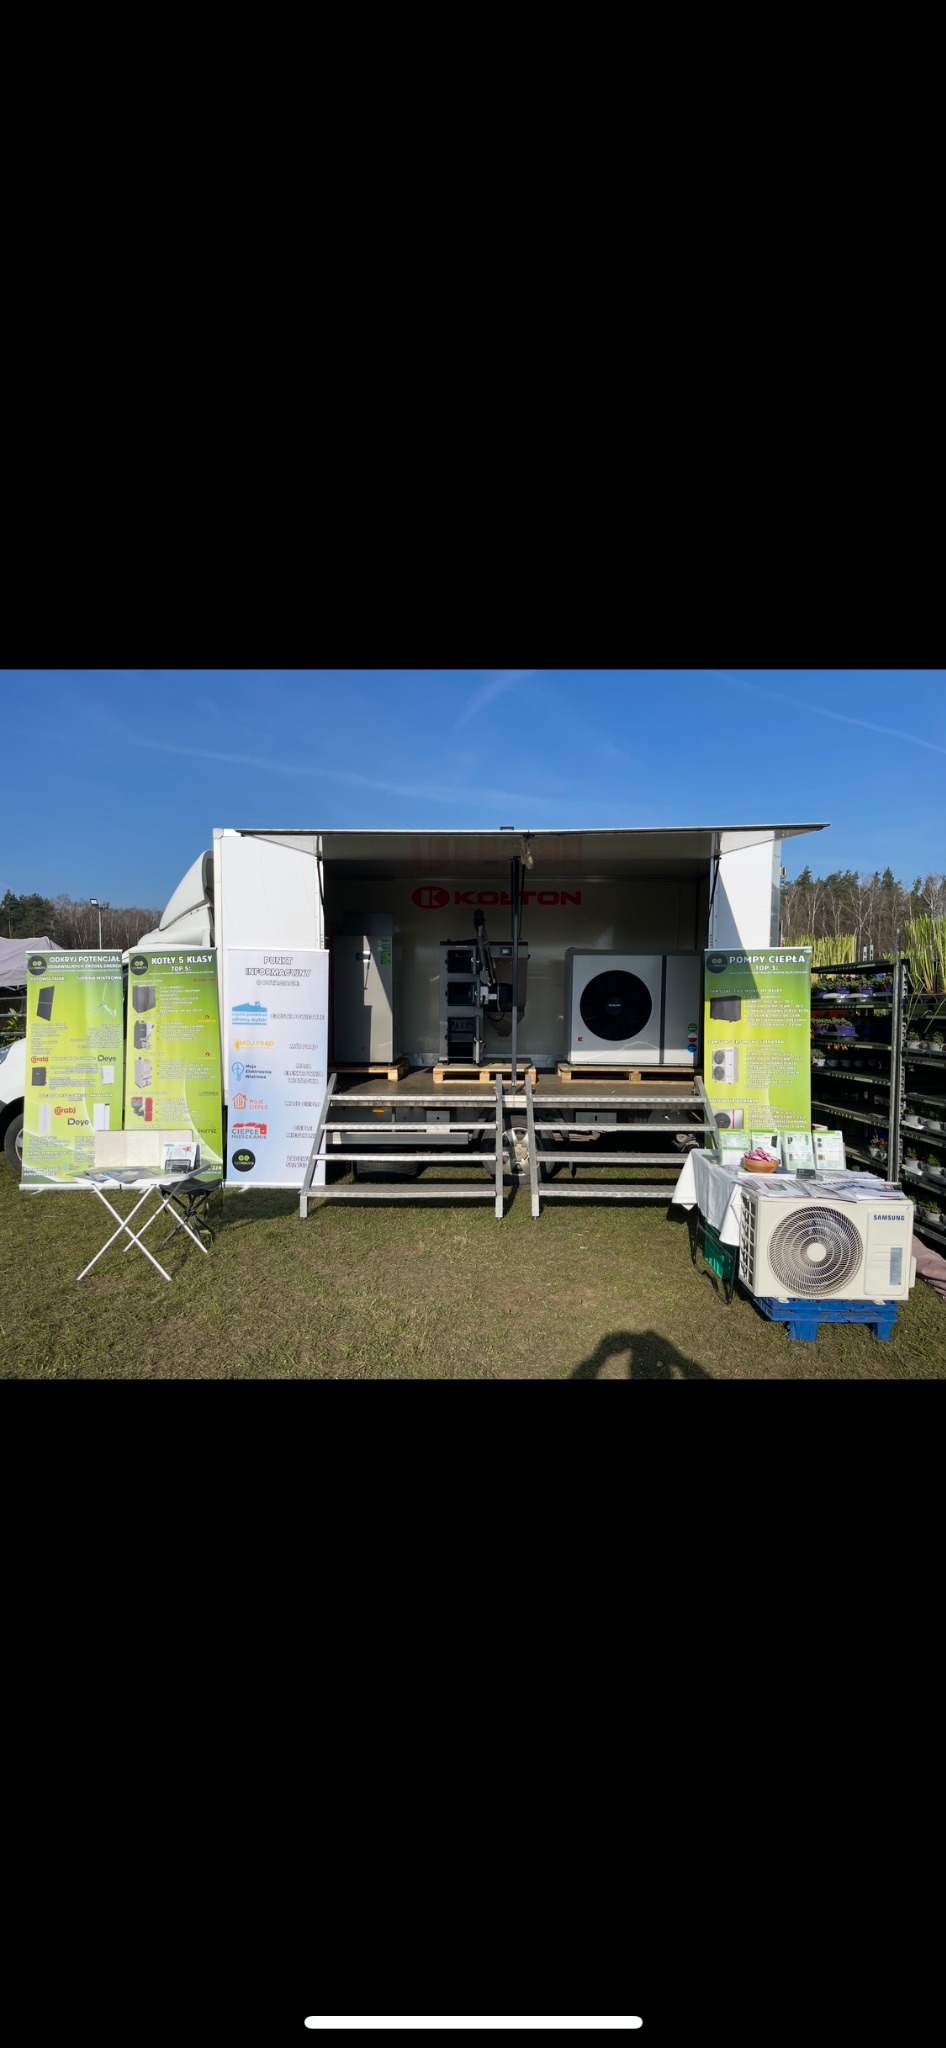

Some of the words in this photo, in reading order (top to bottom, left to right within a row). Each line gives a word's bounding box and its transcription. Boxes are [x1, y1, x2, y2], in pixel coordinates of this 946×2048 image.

[78, 955, 120, 963] POTENCJAŁ
[151, 956, 175, 965] KOTŁY
[178, 956, 184, 964] 5
[186, 955, 213, 963] KLASY
[263, 956, 293, 965] PUNKT
[729, 955, 765, 964] POMPY
[769, 955, 806, 963] CIEPŁA
[245, 967, 312, 977] INFORMACYJNY
